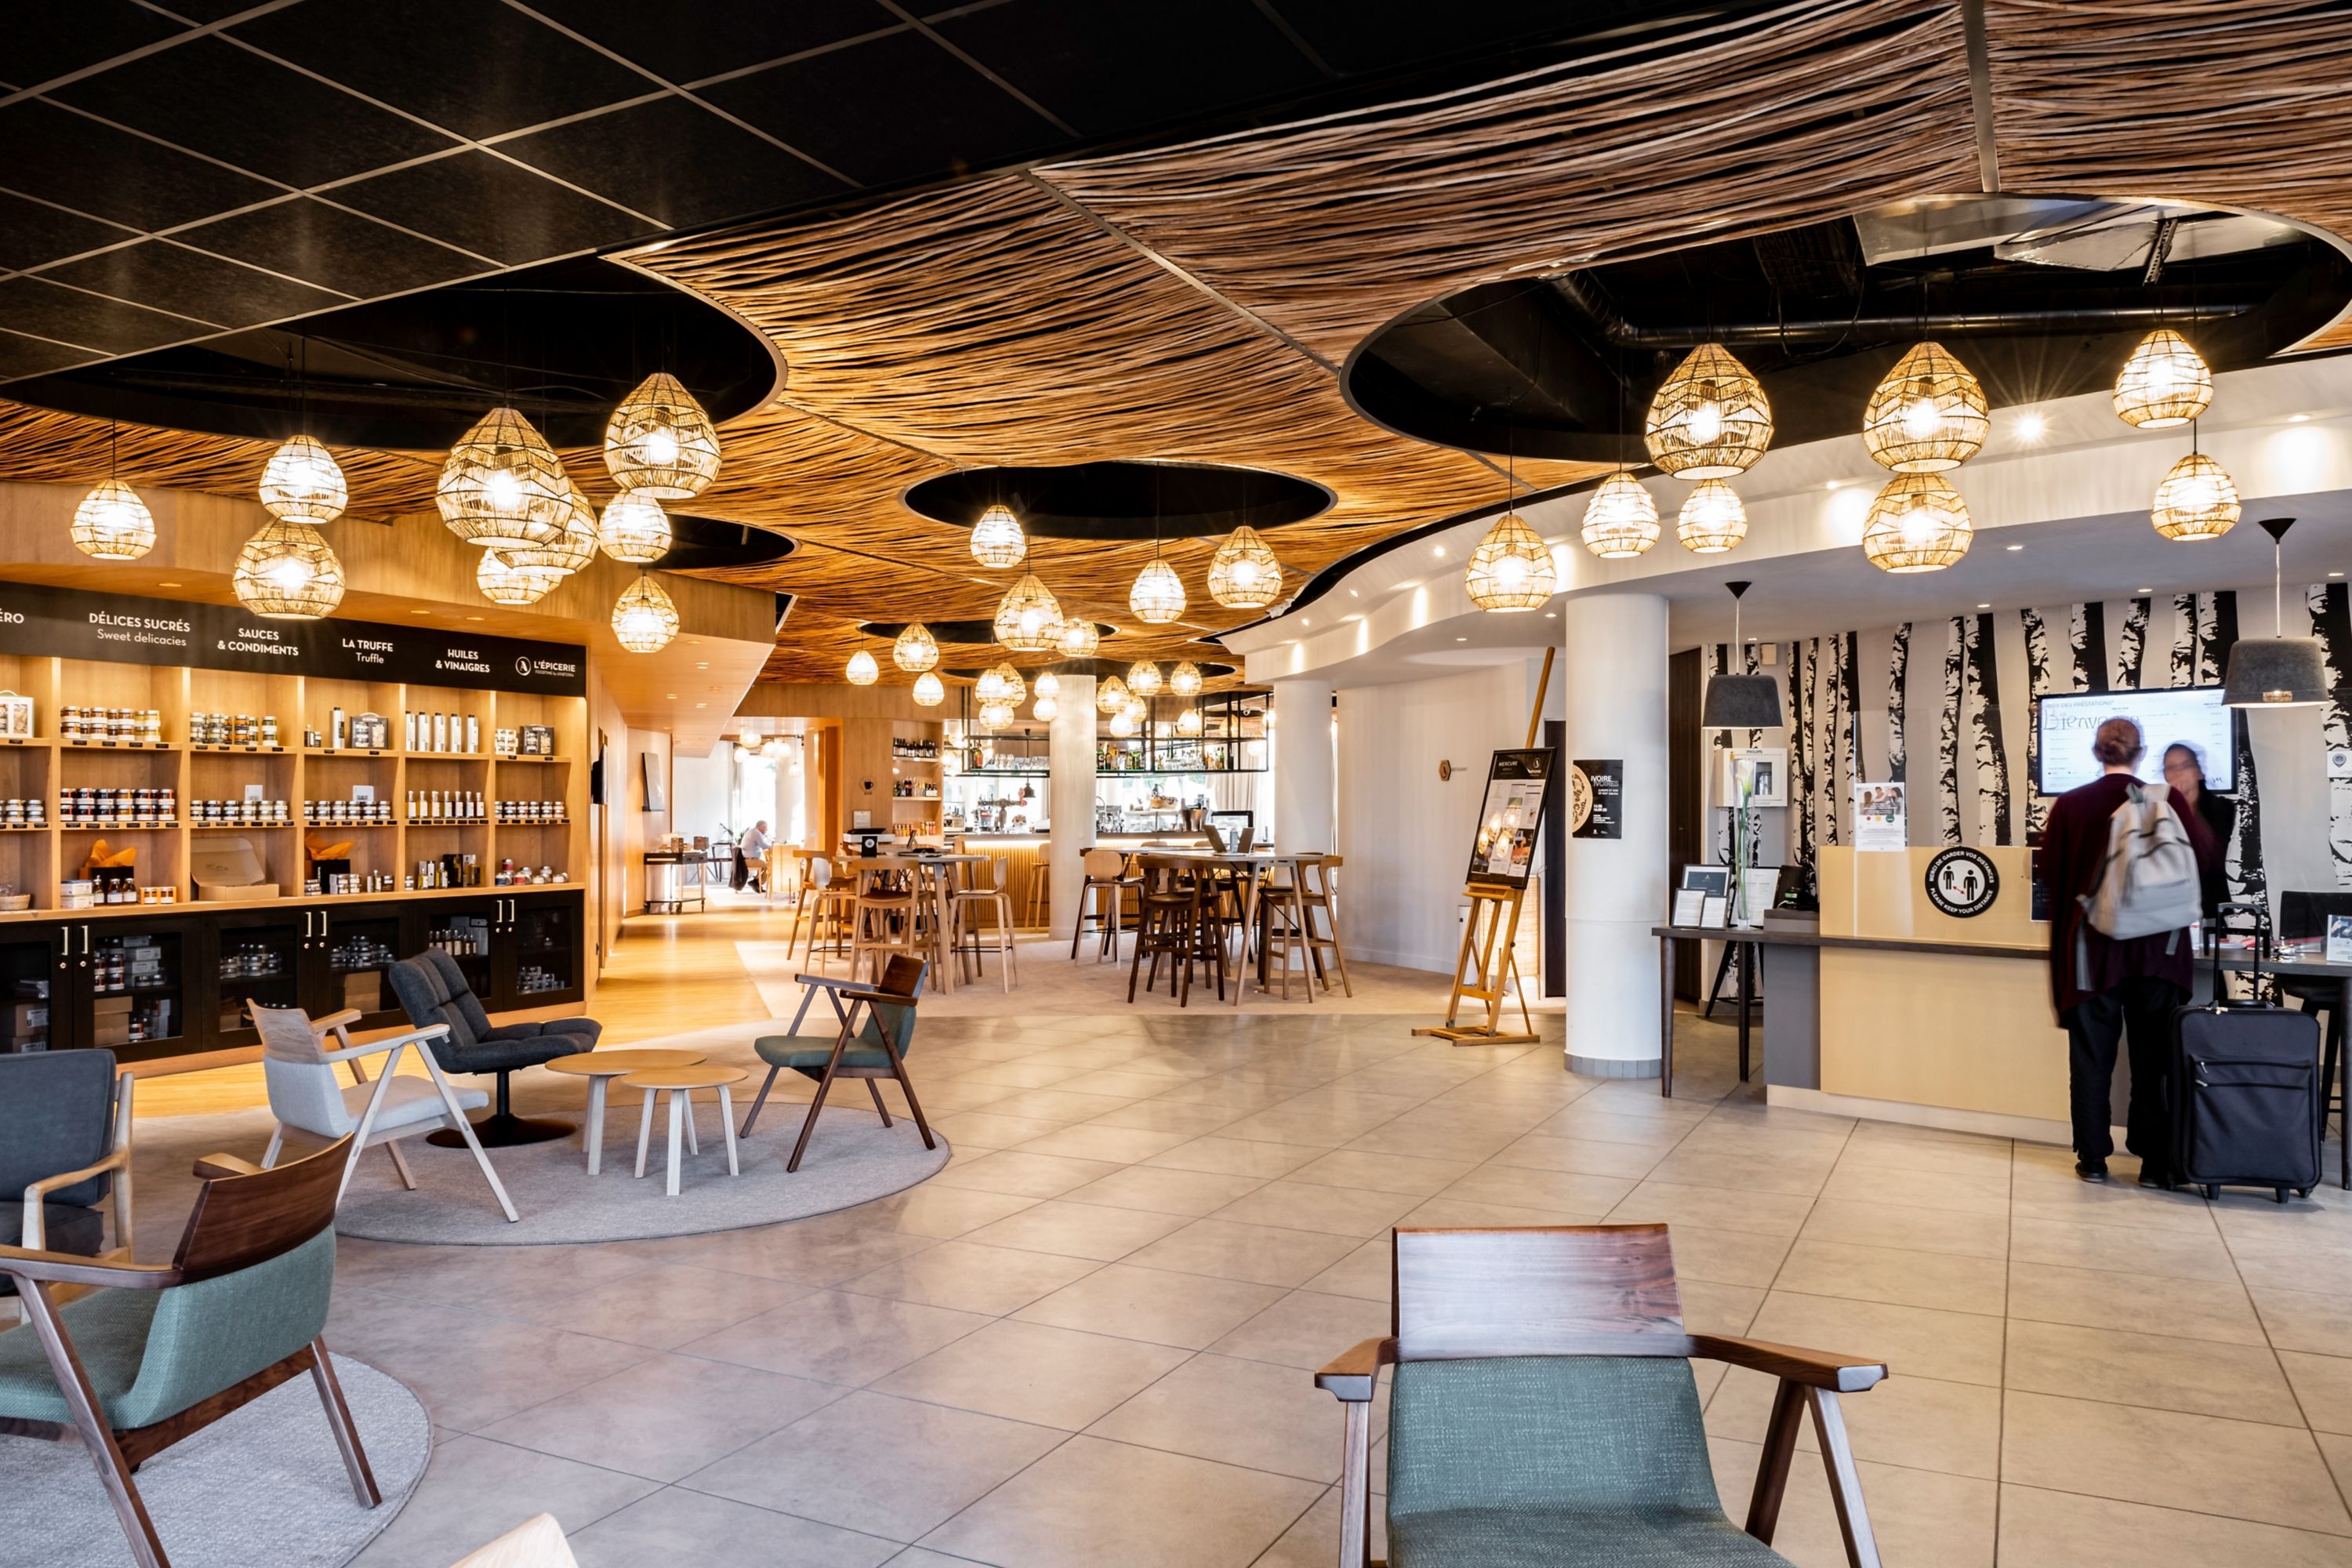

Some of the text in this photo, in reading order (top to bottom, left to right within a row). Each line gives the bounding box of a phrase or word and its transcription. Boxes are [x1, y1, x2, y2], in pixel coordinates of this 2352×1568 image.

[89, 611, 191, 633] DÉLICES SUCRÉS
[97, 629, 187, 646] Sweet delicacies
[238, 628, 279, 641] SAUCES
[217, 641, 299, 656] & CONDIMENTS
[342, 638, 394, 652] LA TRUFFE
[356, 652, 384, 663] Truffle
[448, 648, 478, 660] HUILES
[435, 660, 490, 673] & VINAIGRES
[534, 660, 575, 672] L'ÉPICERIE
[1929, 866, 1937, 882] MERCI
[1942, 851, 1965, 861] GARDER
[1976, 856, 1994, 884] DISTANCES
[1930, 887, 1944, 906] PLEASE
[1944, 904, 1958, 913] KEEP
[1973, 889, 1993, 911] DISTANCE
